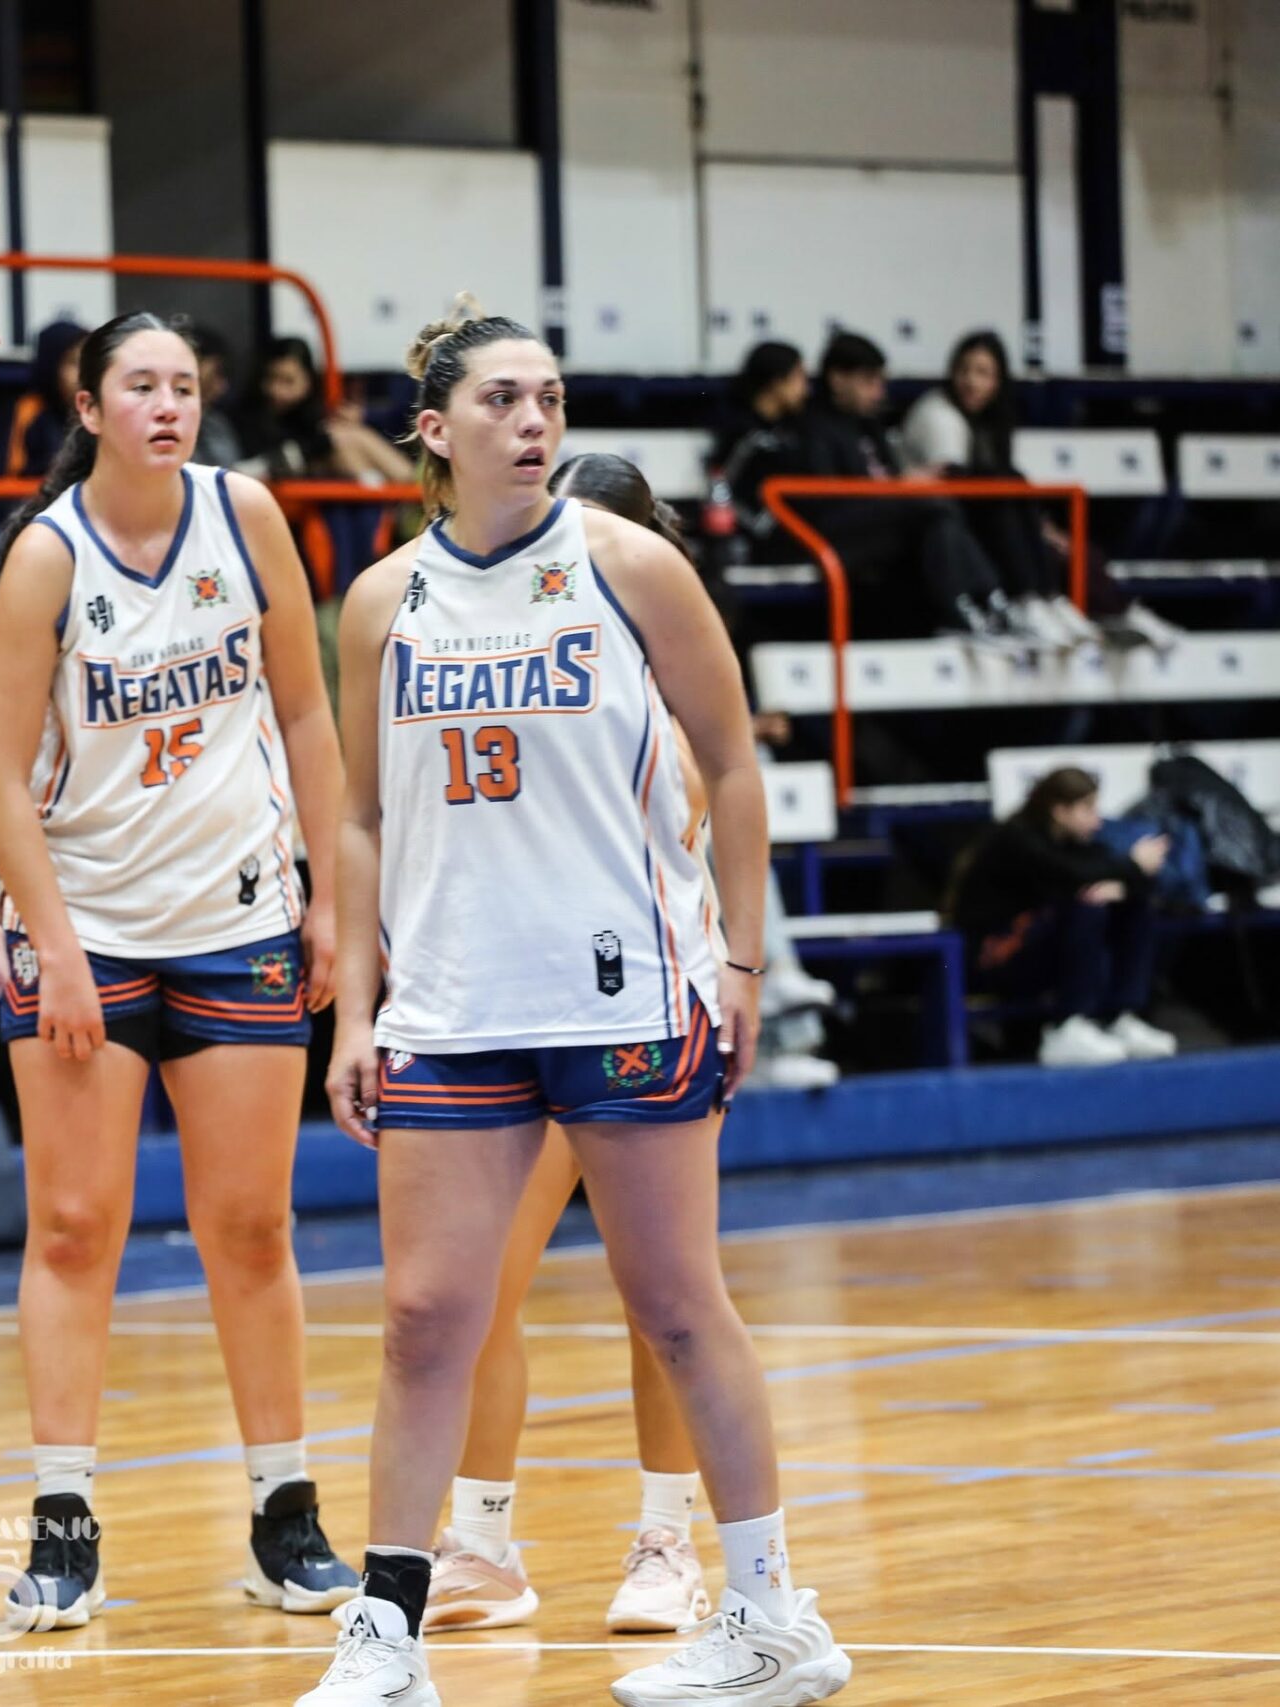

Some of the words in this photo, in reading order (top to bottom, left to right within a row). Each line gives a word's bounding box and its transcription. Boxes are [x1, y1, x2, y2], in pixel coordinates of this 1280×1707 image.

[85, 626, 249, 723] REGATAS
[394, 631, 592, 718] REGATAS
[433, 639, 461, 653] SAN
[140, 717, 204, 788] 15
[441, 725, 522, 806] 13
